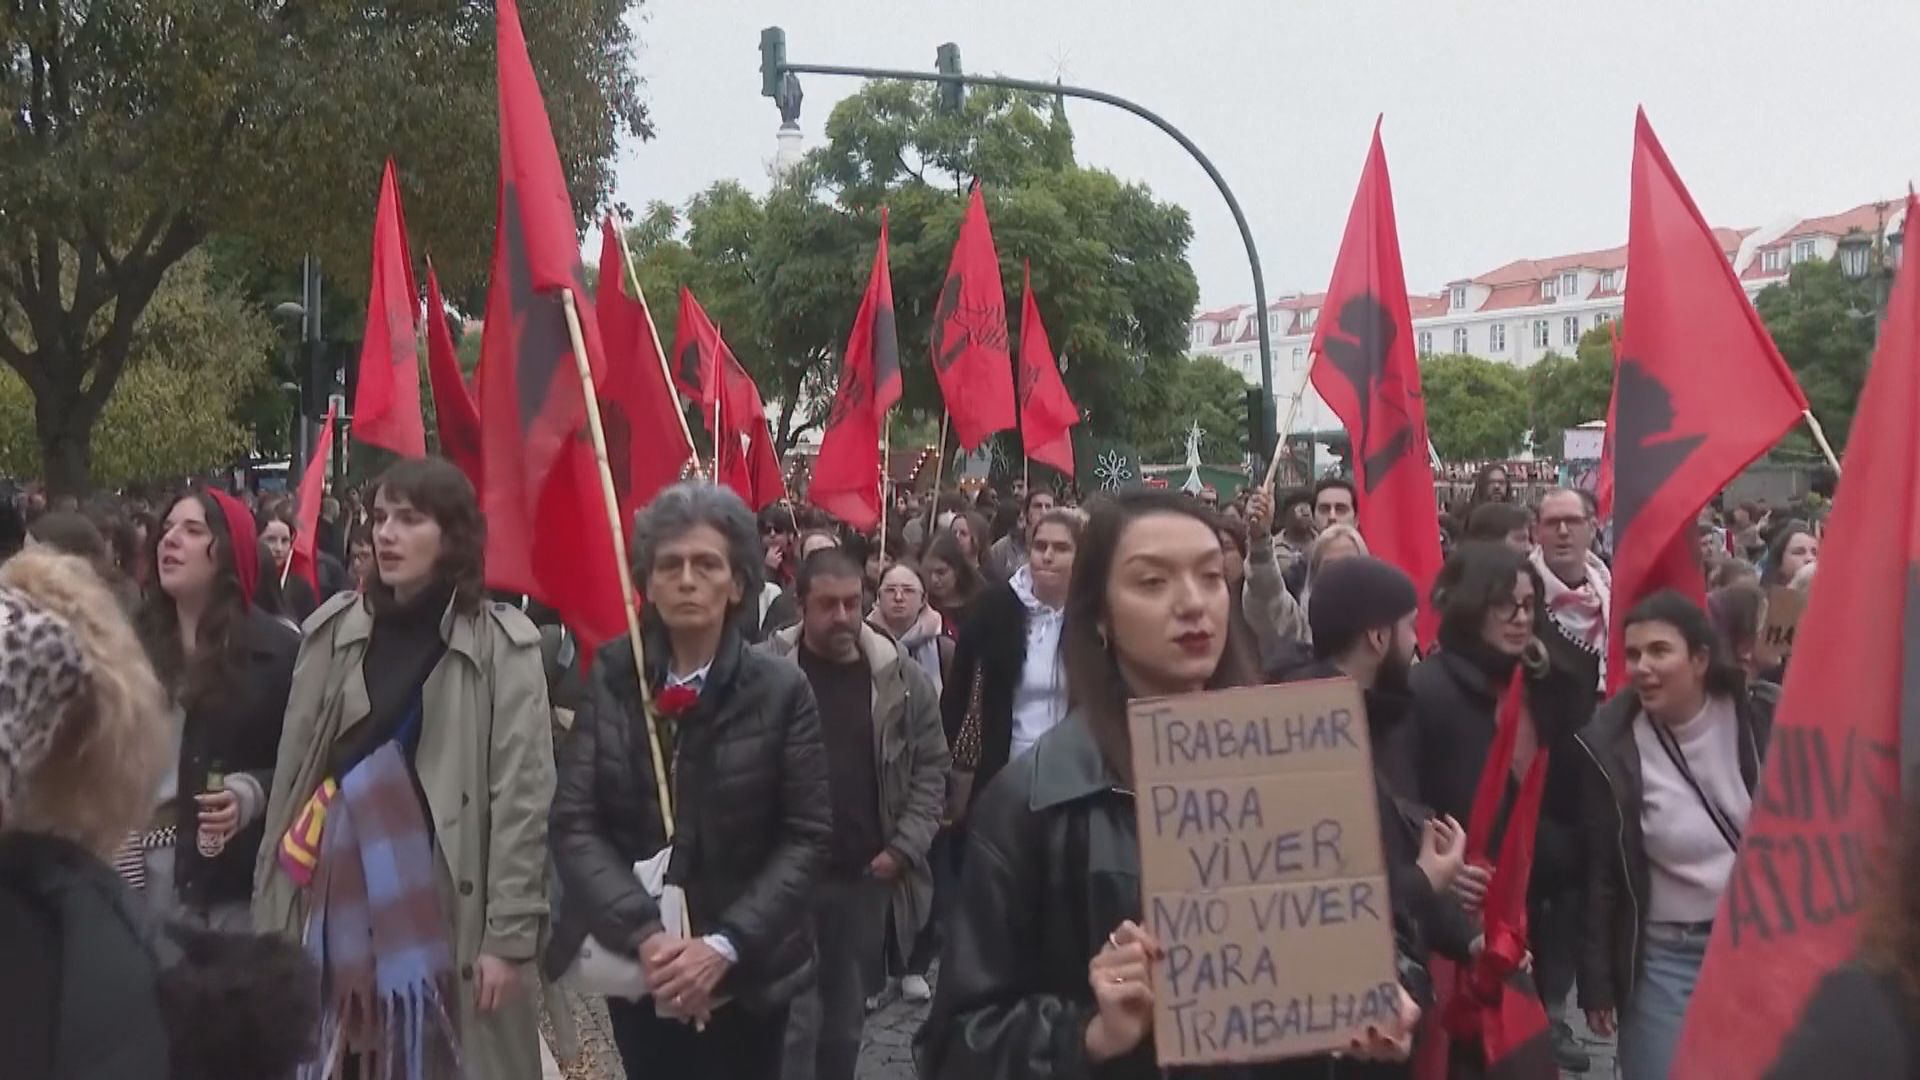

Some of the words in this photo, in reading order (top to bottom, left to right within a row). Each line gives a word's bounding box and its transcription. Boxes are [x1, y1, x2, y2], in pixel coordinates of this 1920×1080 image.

[1136, 707, 1359, 768] TRABALHAR
[1151, 784, 1264, 839] PARA
[1250, 881, 1380, 933] VIVER
[1165, 944, 1278, 998] PARA
[1168, 981, 1400, 1057] TRABALHAR
